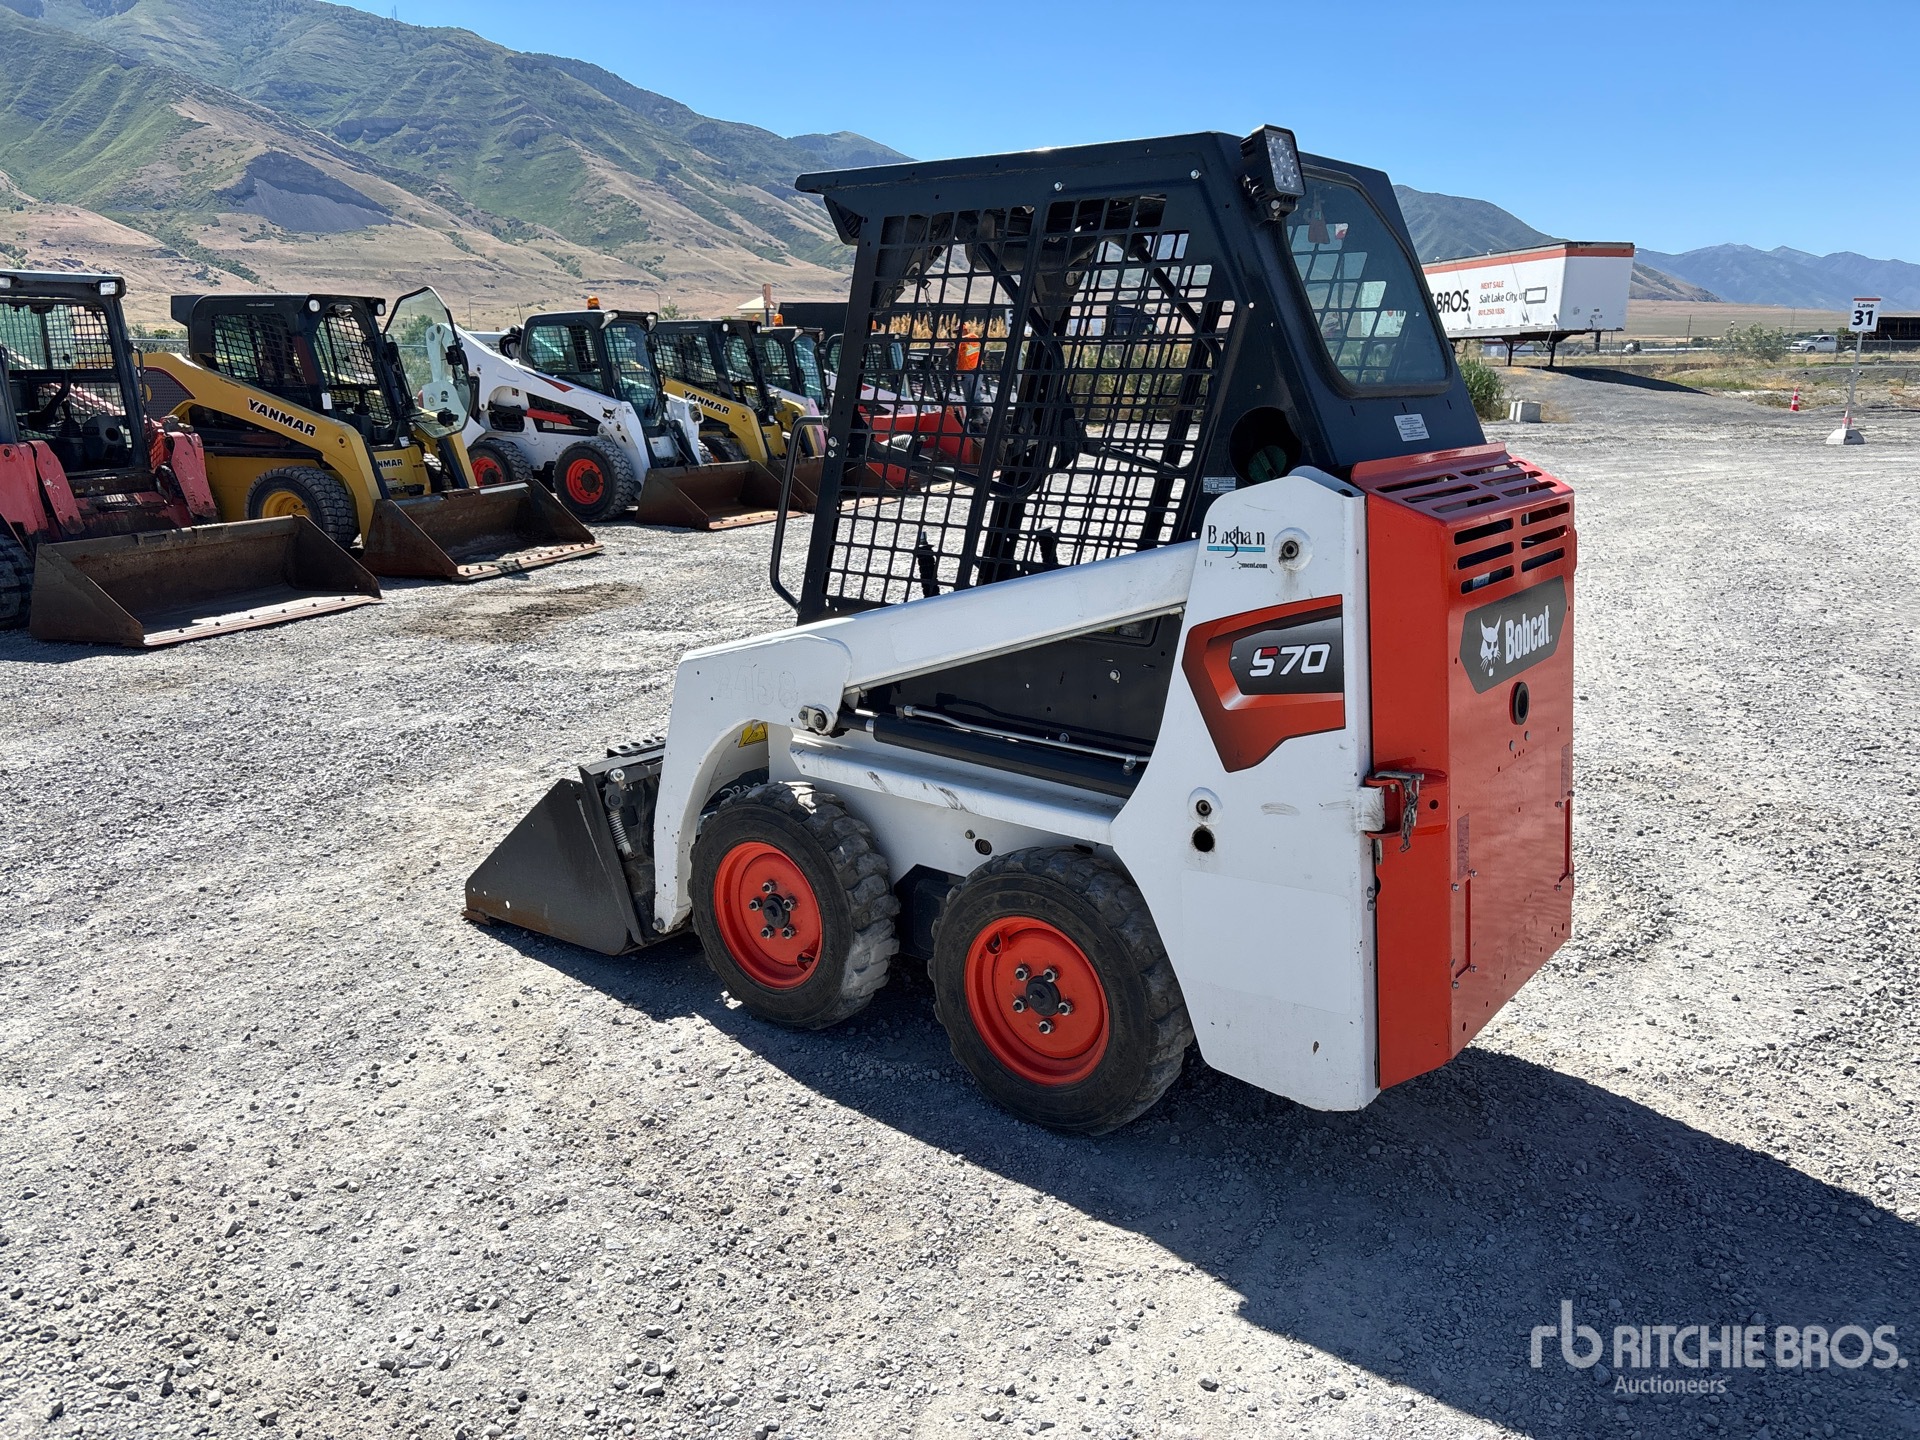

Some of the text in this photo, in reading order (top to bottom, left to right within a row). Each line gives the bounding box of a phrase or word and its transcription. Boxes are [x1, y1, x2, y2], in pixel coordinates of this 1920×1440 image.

[1436, 289, 1471, 313] BROS.
[1479, 293, 1490, 303] Salt
[1491, 292, 1504, 303] Lake
[1852, 310, 1874, 326] 31
[684, 390, 730, 415] YANMAR
[248, 398, 317, 437] YANMAR
[377, 459, 403, 468] NMAR
[1505, 605, 1550, 665] Bobcat
[1249, 643, 1332, 677] S70
